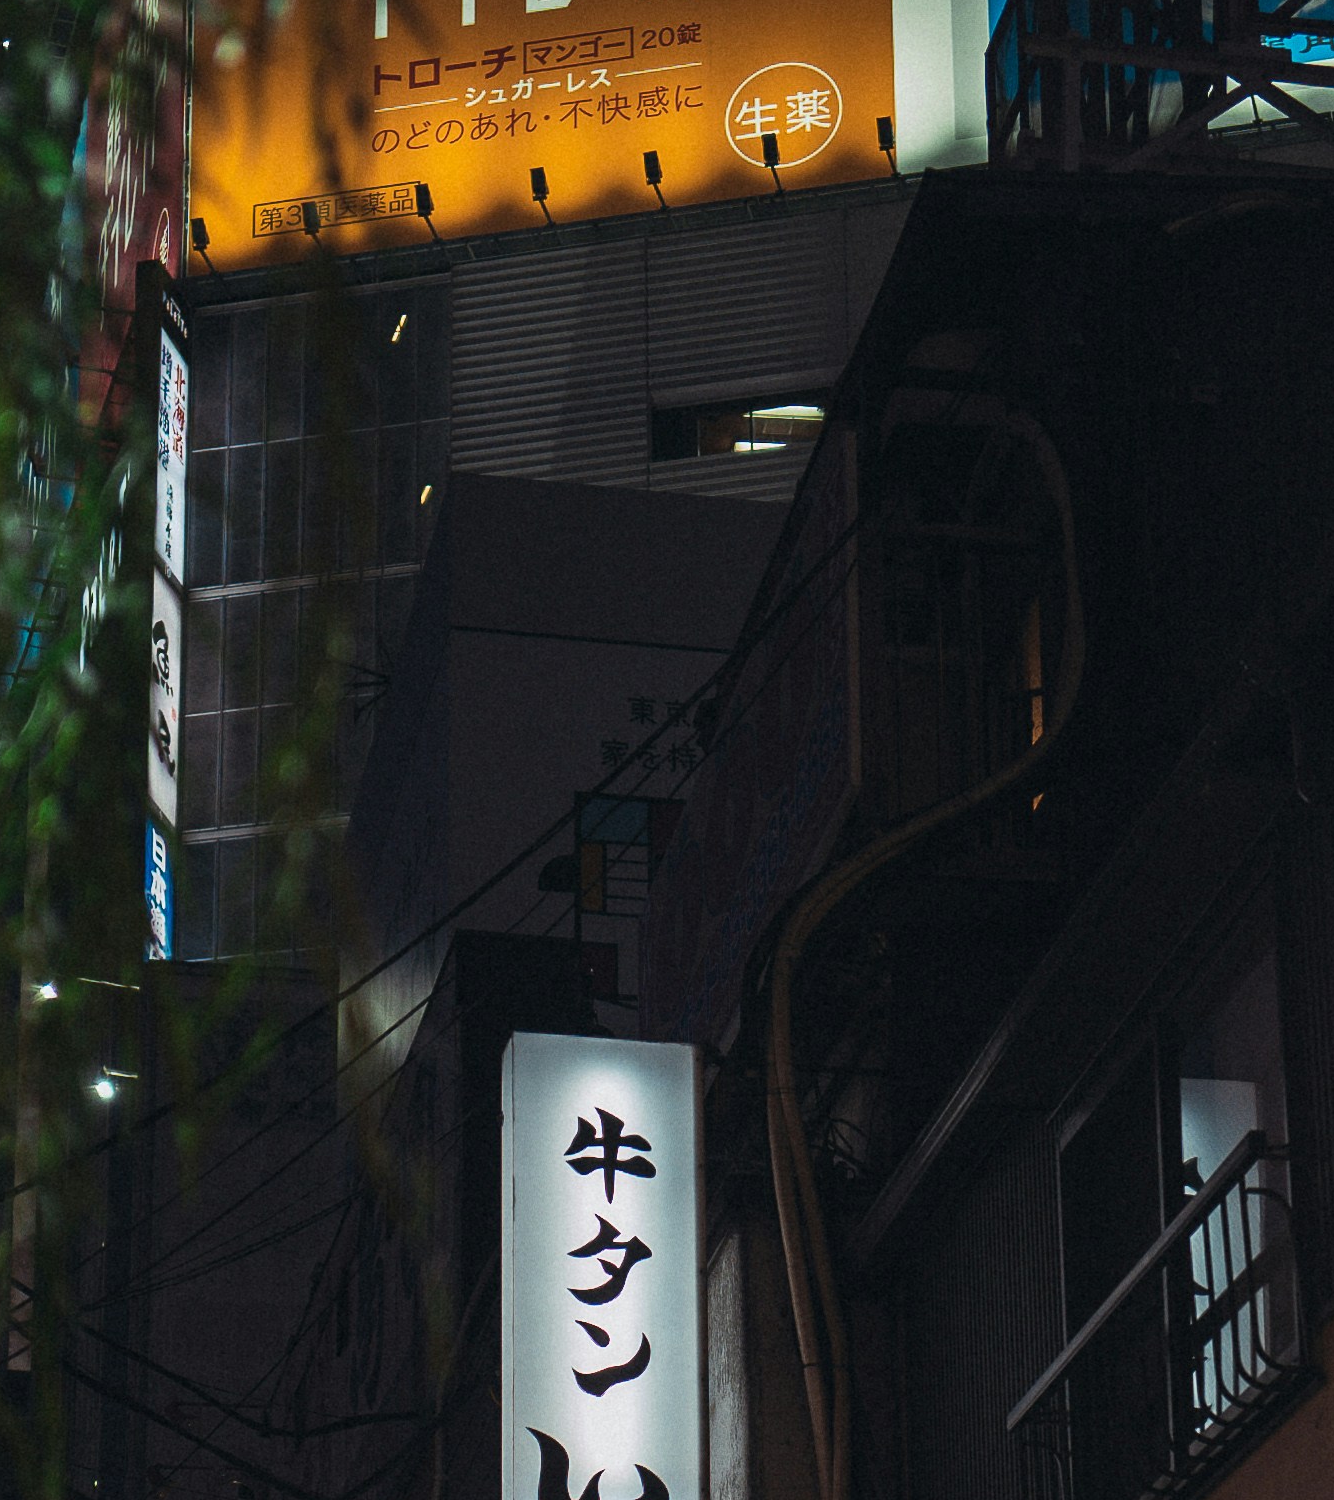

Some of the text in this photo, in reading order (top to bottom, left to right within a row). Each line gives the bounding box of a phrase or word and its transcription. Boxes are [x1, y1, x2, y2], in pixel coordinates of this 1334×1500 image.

[373, 23, 703, 97] トローチ マンゴー 20錠
[464, 68, 612, 108] シュガーレス
[371, 84, 704, 155] のどのあれ・不快感に
[733, 89, 832, 141] 生薬
[152, 620, 176, 777] 魚民
[148, 827, 168, 961] 日本海
[563, 1106, 657, 1399] 牛タン
